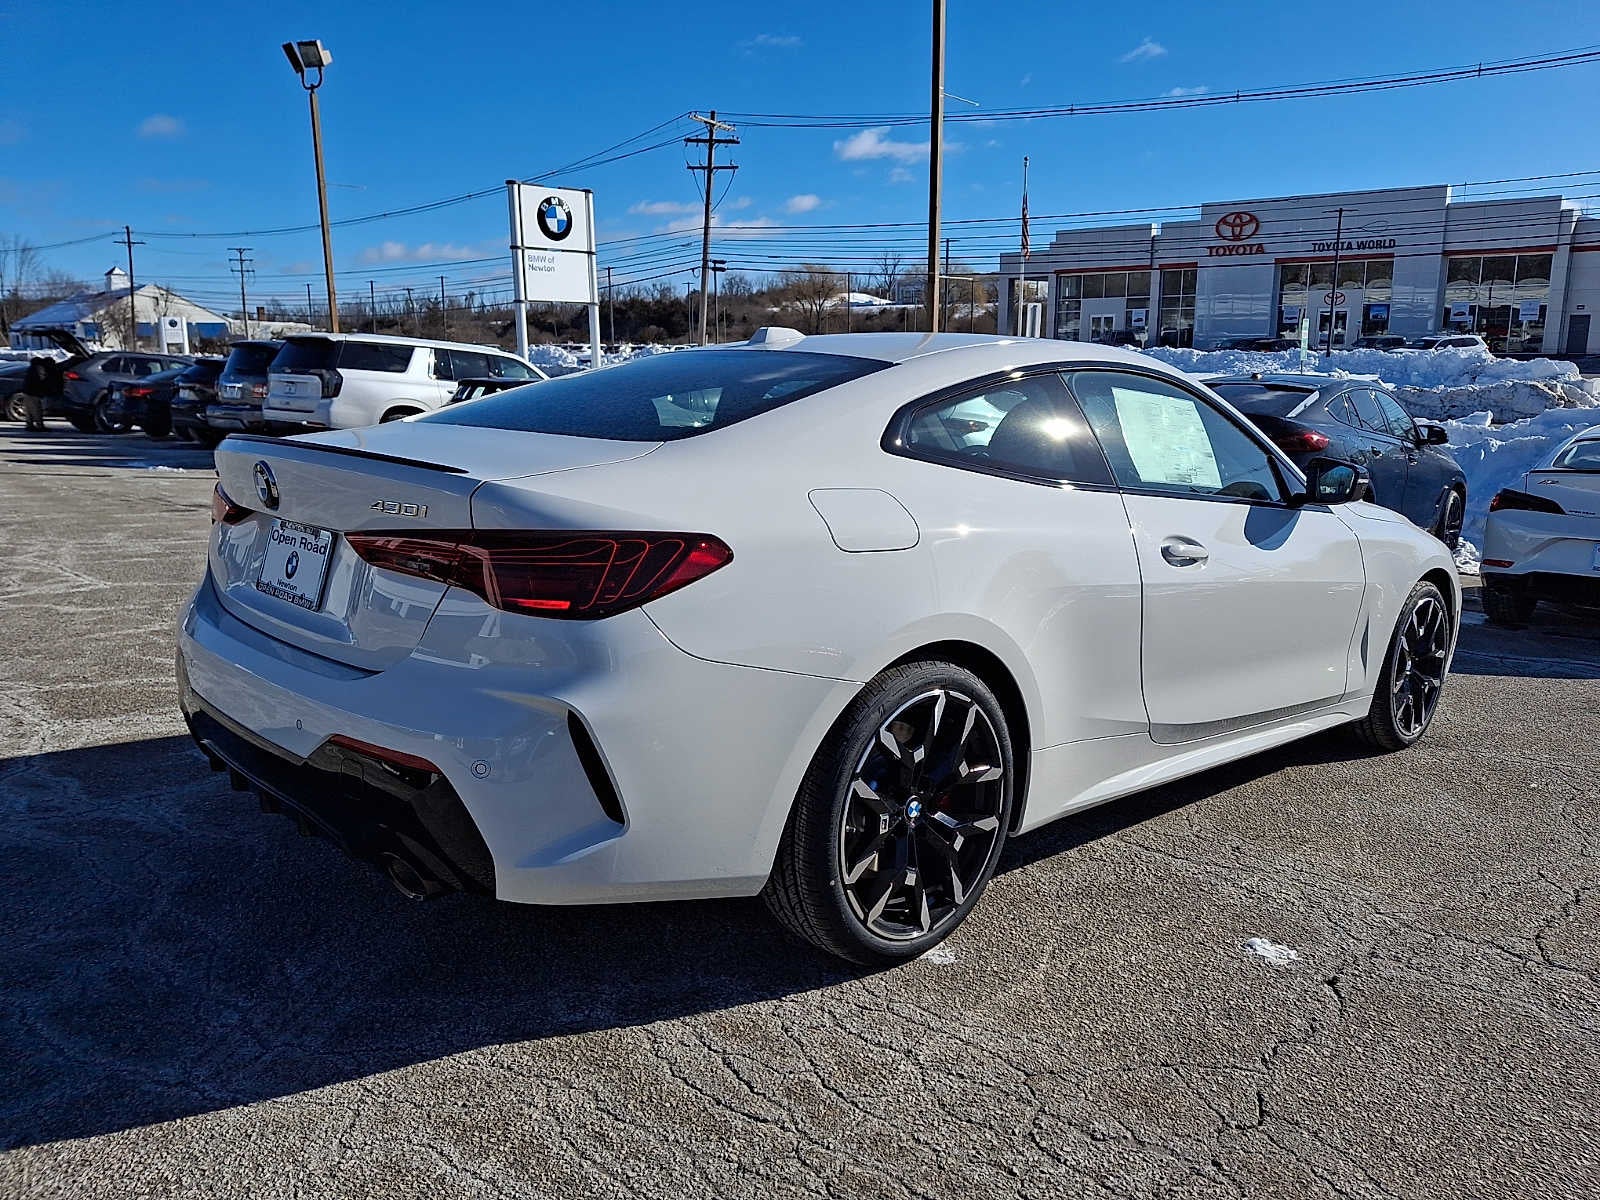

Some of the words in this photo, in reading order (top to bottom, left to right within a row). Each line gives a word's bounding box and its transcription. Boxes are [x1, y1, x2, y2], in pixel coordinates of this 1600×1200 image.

[540, 197, 570, 213] BMW
[1207, 244, 1265, 257] TOYOTA
[1312, 240, 1354, 253] TOYOTA
[1356, 238, 1396, 250] WORLD
[527, 255, 546, 263] BMW
[528, 264, 555, 272] Newton
[369, 500, 428, 518] 430i
[271, 528, 297, 546] Open
[299, 536, 328, 555] Road
[276, 578, 298, 592] Newton
[258, 583, 274, 596] OPEN
[275, 589, 293, 603] ROAD
[294, 595, 312, 609] BMW
